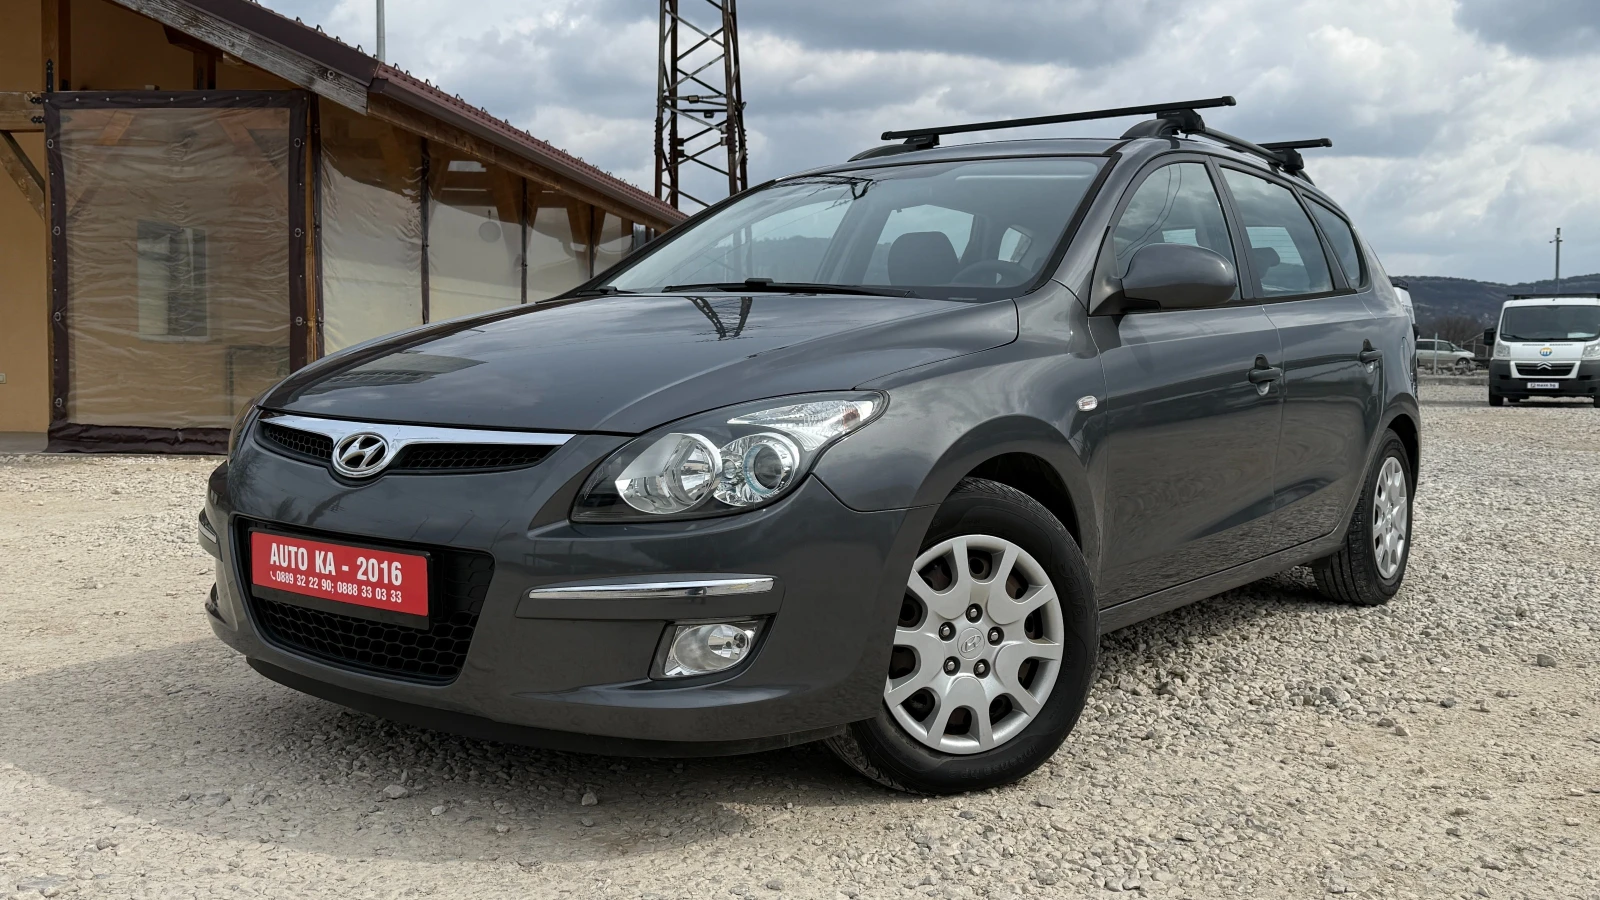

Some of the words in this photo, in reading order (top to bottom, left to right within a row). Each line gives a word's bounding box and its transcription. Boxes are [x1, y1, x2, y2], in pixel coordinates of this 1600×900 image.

[270, 543, 308, 571] AUTO
[315, 550, 336, 576] KA
[341, 565, 350, 573] -
[357, 557, 402, 586] 2016
[276, 570, 294, 585] 0889
[296, 574, 307, 587] 32
[308, 576, 319, 589] 22
[321, 578, 335, 594] 90;
[337, 581, 358, 596] 0888
[361, 585, 373, 599] 33
[375, 587, 387, 601] 03
[390, 589, 402, 603] 33
